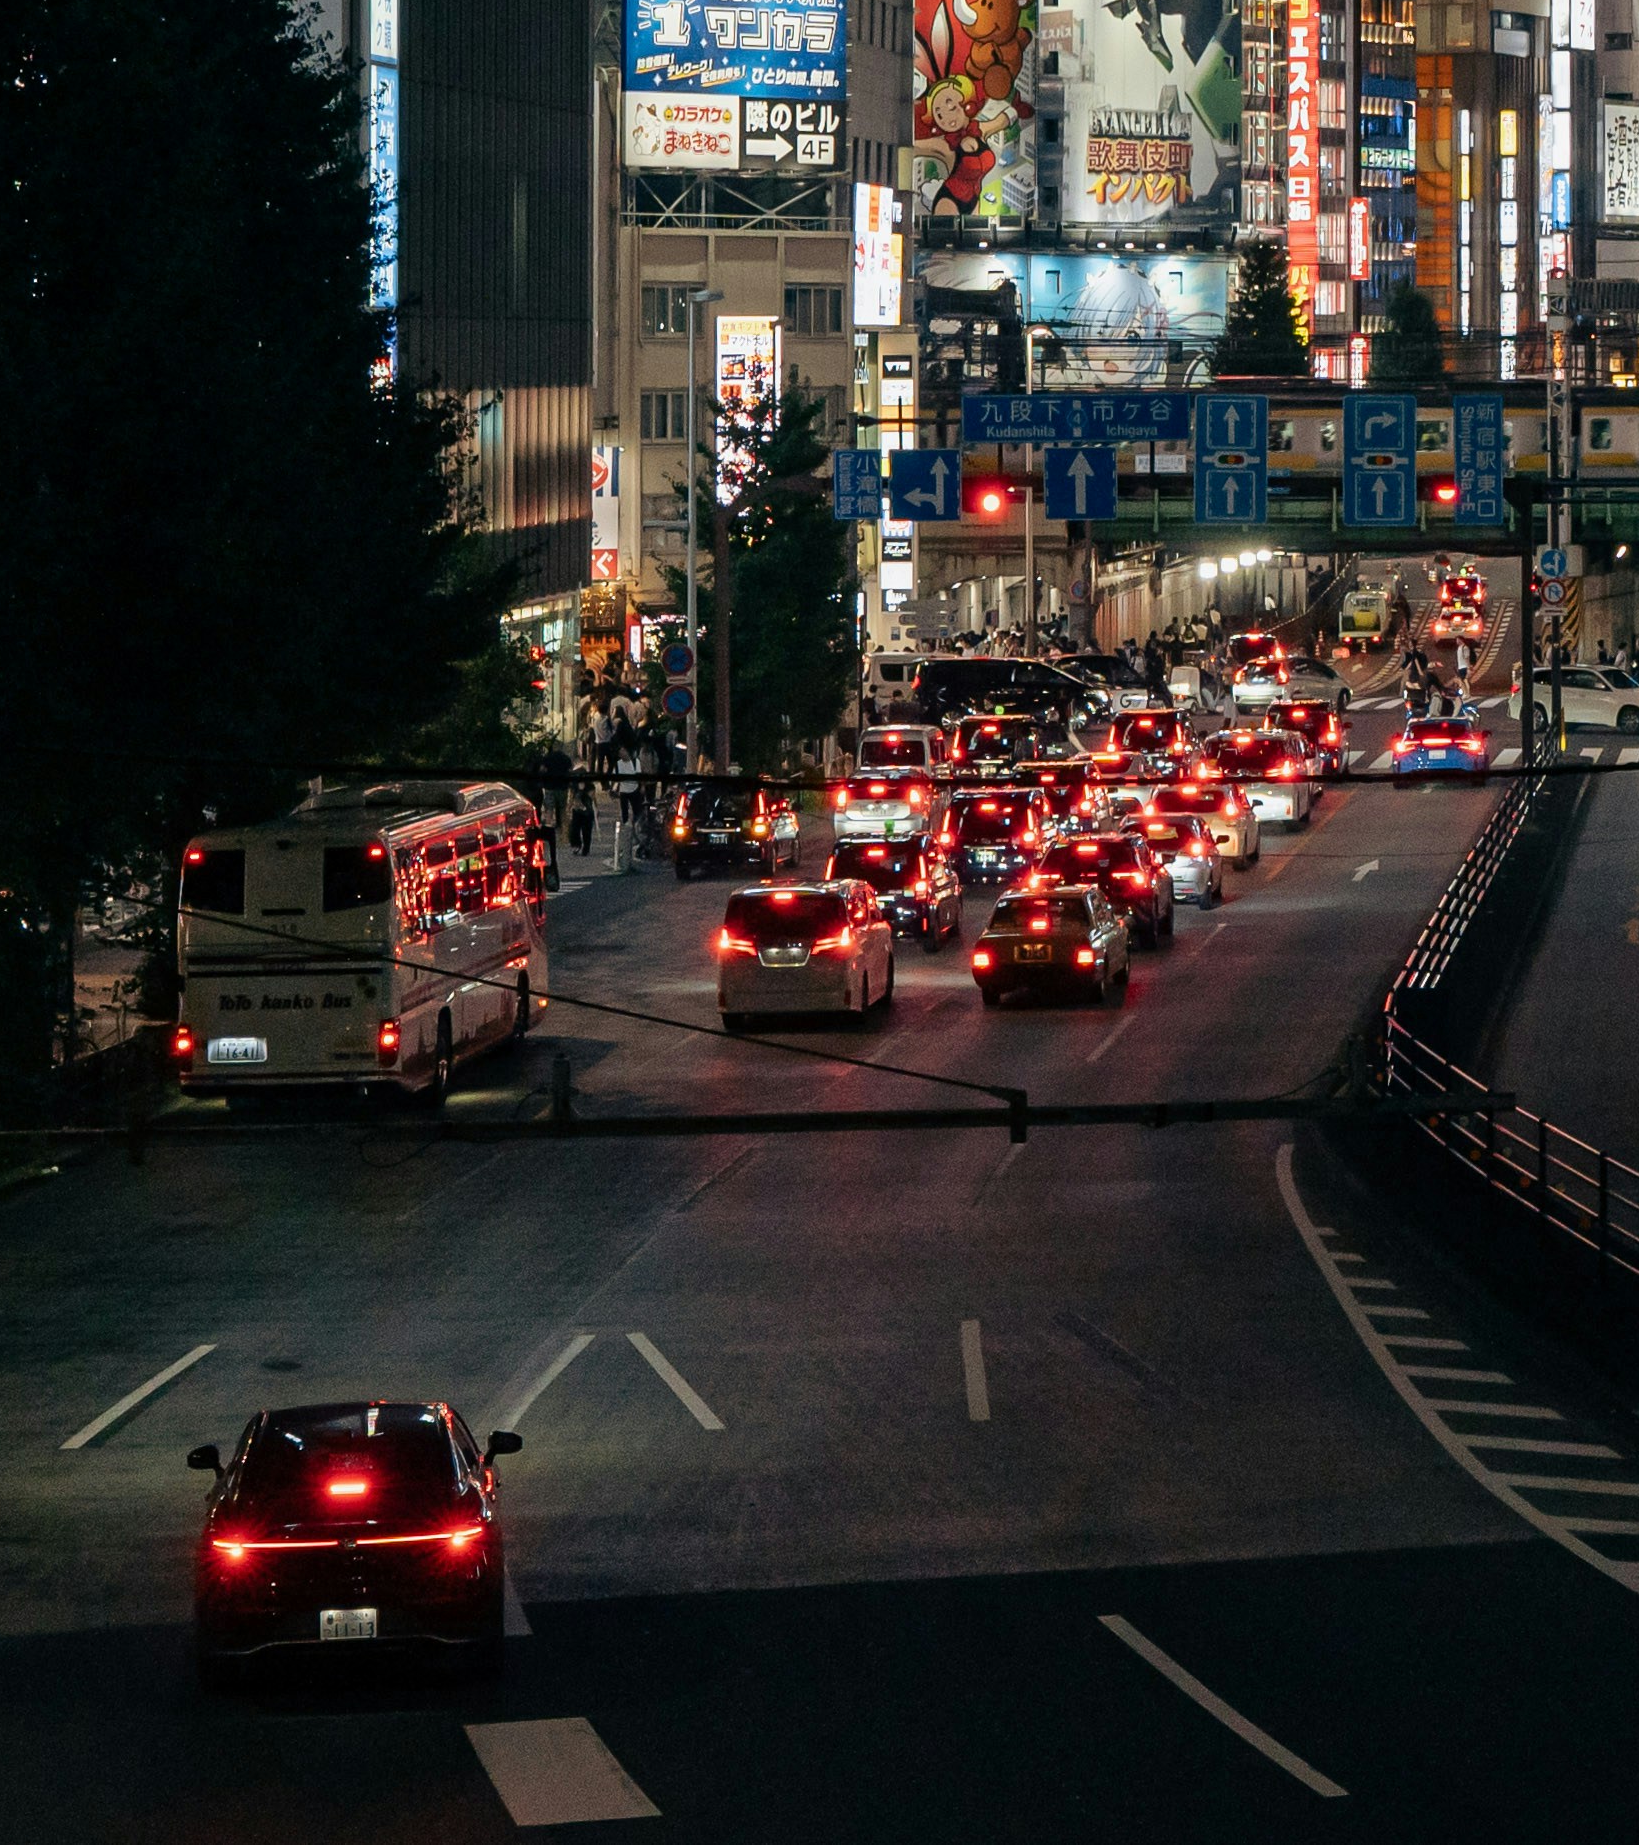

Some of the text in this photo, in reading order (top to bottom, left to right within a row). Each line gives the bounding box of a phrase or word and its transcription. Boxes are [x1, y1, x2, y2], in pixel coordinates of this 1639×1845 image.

[703, 5, 839, 53] ワンカラ
[673, 106, 723, 123] カラオケ
[745, 100, 840, 133] 隣のビル
[663, 128, 732, 156] まねきねこ
[801, 139, 830, 160] 4F
[1087, 138, 1194, 173] 歌舞伎町
[1086, 170, 1194, 204] インパクト
[979, 400, 1061, 423] 九段下
[1091, 399, 1172, 422] 市ヶ谷
[985, 425, 1057, 438] Kudanshita
[1105, 425, 1158, 439] Ichigaya
[1460, 405, 1475, 464] Shinjuku
[1476, 402, 1496, 517] 新宿駅東口
[321, 994, 353, 1009] Bus
